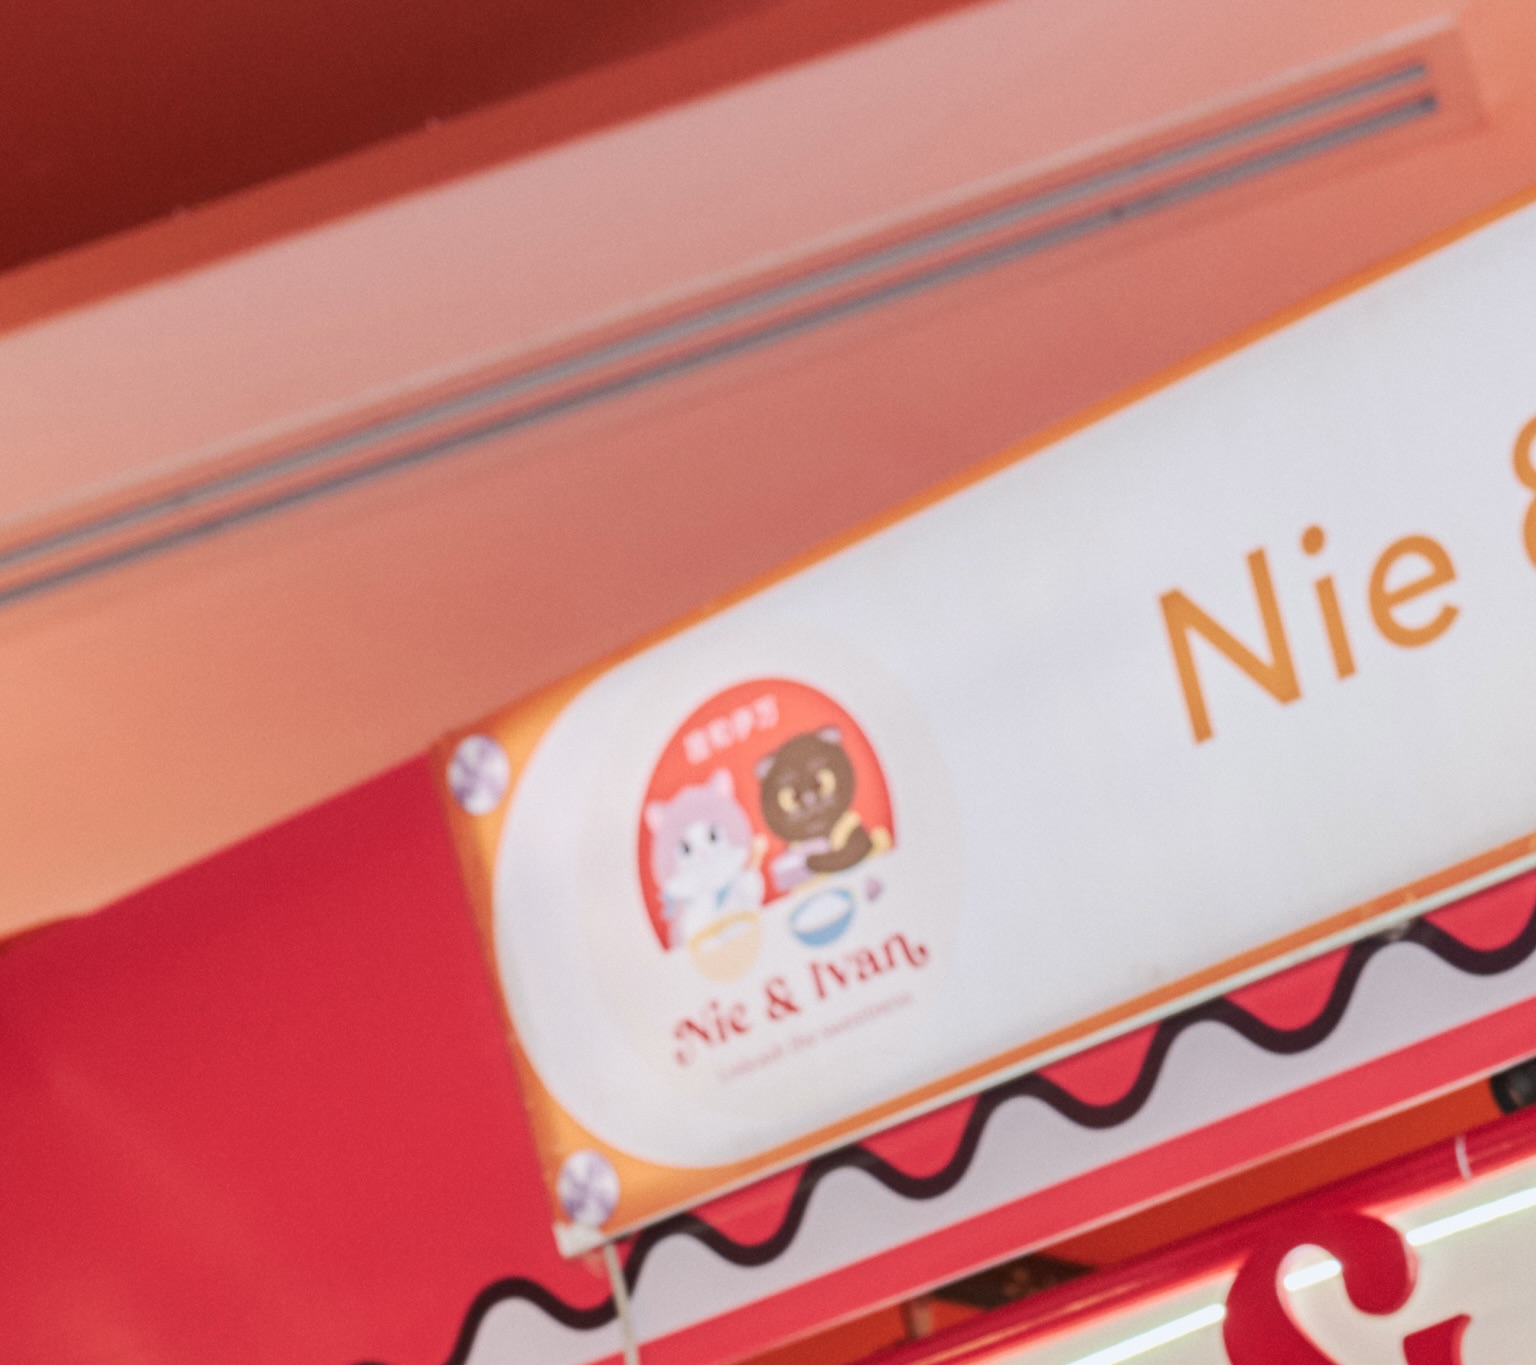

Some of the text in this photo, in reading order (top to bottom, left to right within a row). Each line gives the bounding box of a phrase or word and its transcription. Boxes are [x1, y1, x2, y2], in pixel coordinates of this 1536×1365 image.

[1156, 524, 1460, 745] Nie
[673, 998, 750, 1068] Nie
[763, 975, 802, 1022] &
[807, 932, 930, 1001] Ivan
